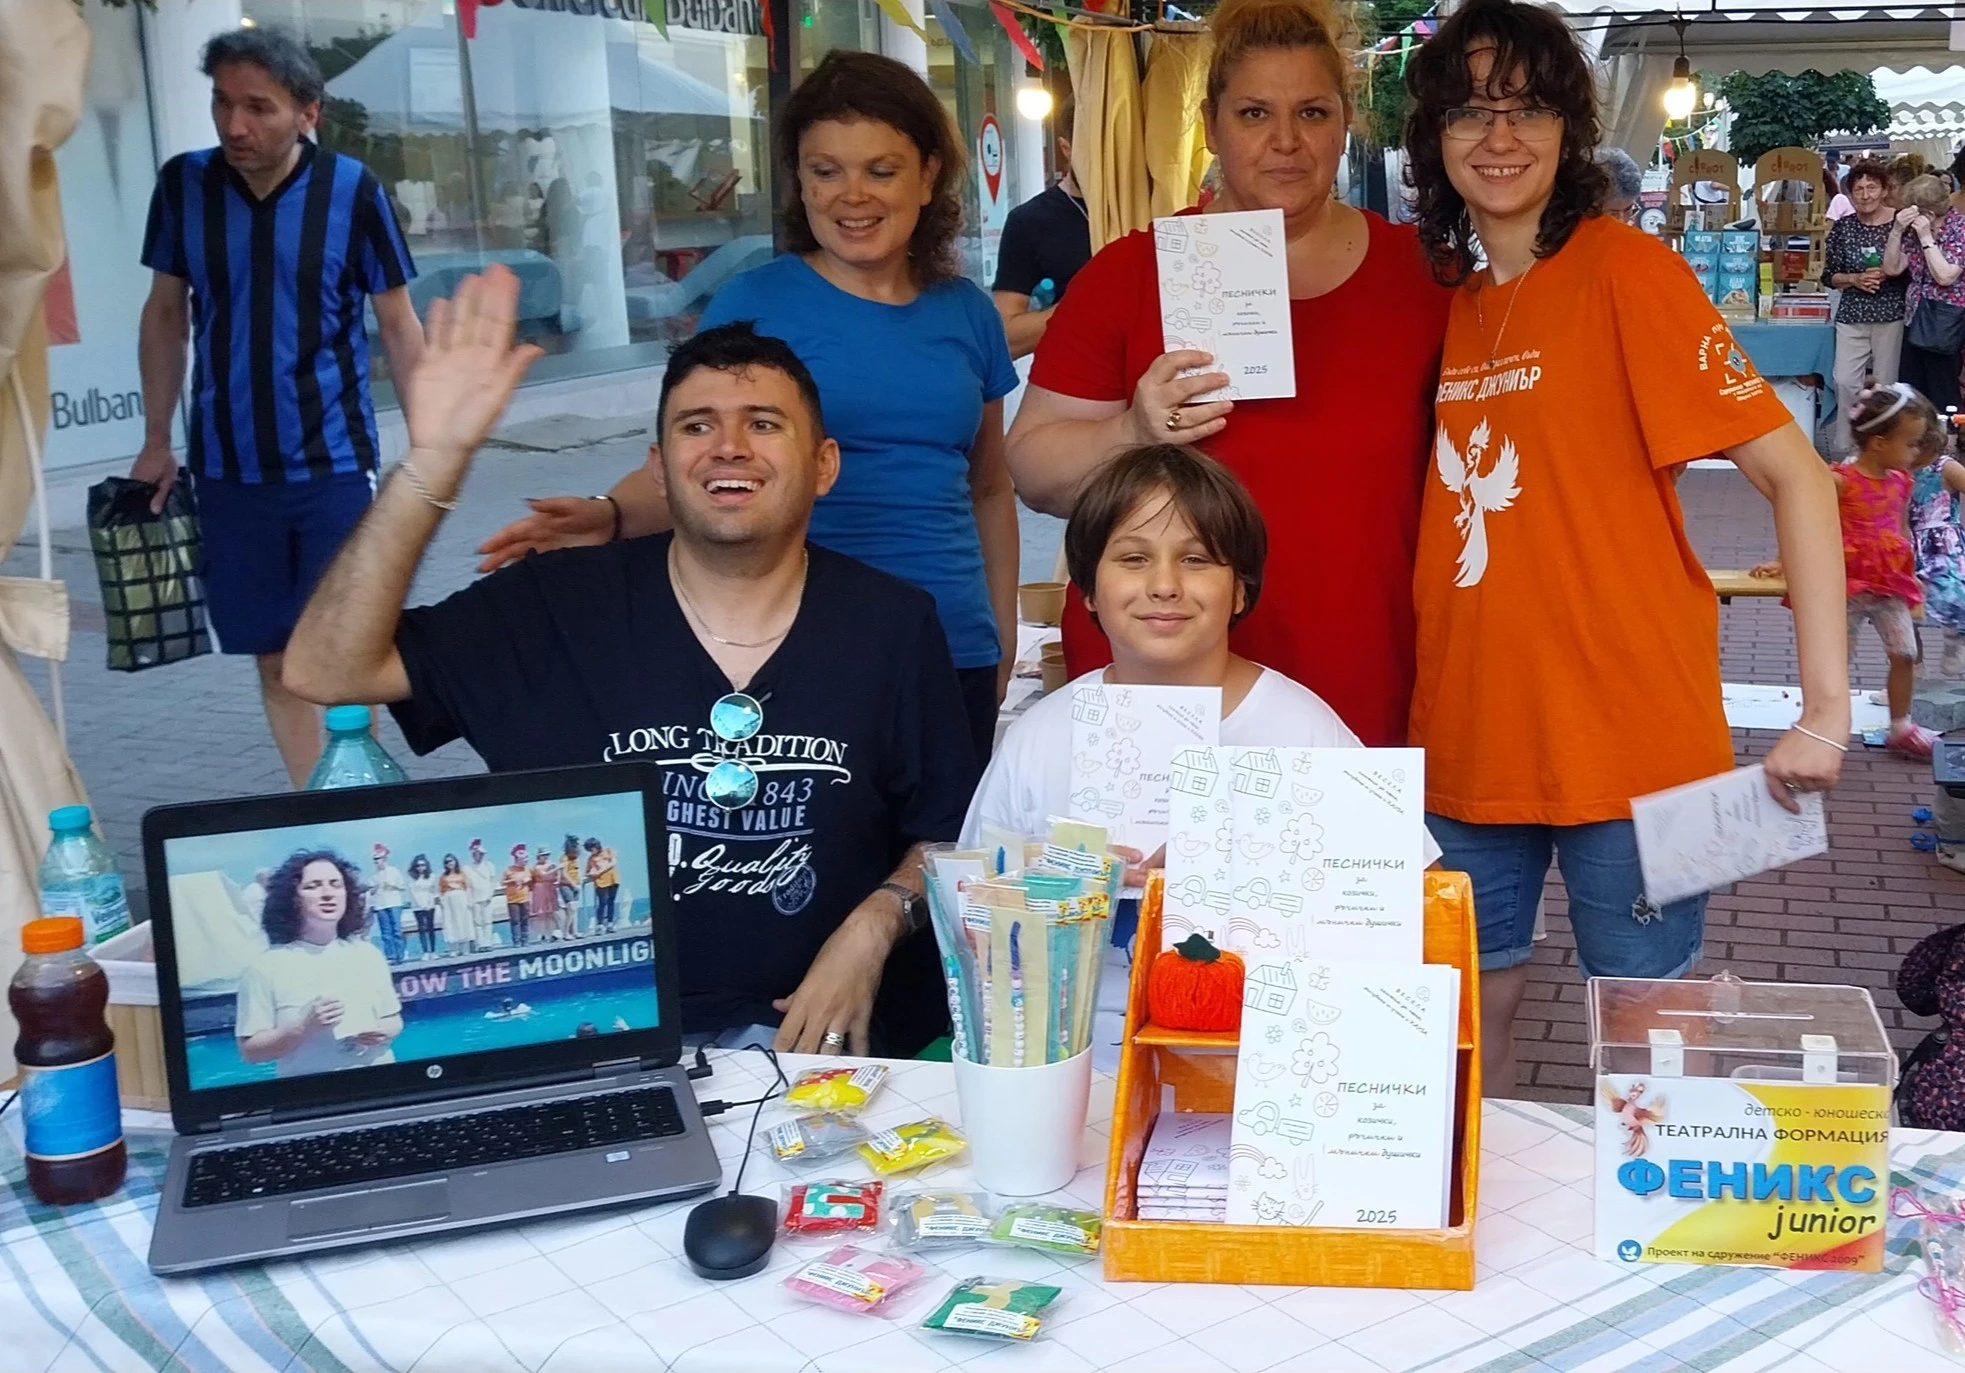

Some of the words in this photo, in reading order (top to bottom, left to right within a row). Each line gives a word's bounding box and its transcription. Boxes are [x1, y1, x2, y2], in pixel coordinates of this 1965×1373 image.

[666, 0, 760, 35] Bulban
[1222, 289, 1277, 298] ПЕСНИЧКИ
[1699, 335, 1712, 370] ВАРНА
[1243, 365, 1268, 375] 2025
[1476, 366, 1541, 402] ДЖУНИЪР
[51, 388, 144, 430] Bulban
[609, 726, 690, 755] LONG
[662, 772, 711, 801] INC
[749, 778, 813, 805] 843
[1139, 773, 1170, 782] ПЕСН
[667, 800, 731, 829] GHEST
[741, 805, 806, 831] VALUE
[691, 838, 813, 886] Quality
[1322, 858, 1405, 870] ПЕСНИЧКИ
[397, 974, 448, 998] OW
[457, 962, 511, 989] THE
[519, 940, 655, 980] MOONLIG
[1337, 1082, 1427, 1095] ПЕСНИЧКИ
[1744, 1103, 1802, 1118] детско
[1655, 1124, 1767, 1140] ТЕАТРАЛНА
[1773, 1129, 1888, 1145] ФОРМАЦИЯ
[1617, 1158, 1876, 1204] ФЕНИКС
[1356, 1209, 1397, 1224] 2025
[1768, 1205, 1877, 1240] junior
[1647, 1247, 1689, 1260] Проект
[1692, 1249, 1705, 1257] на
[1707, 1249, 1770, 1261] сдружение
